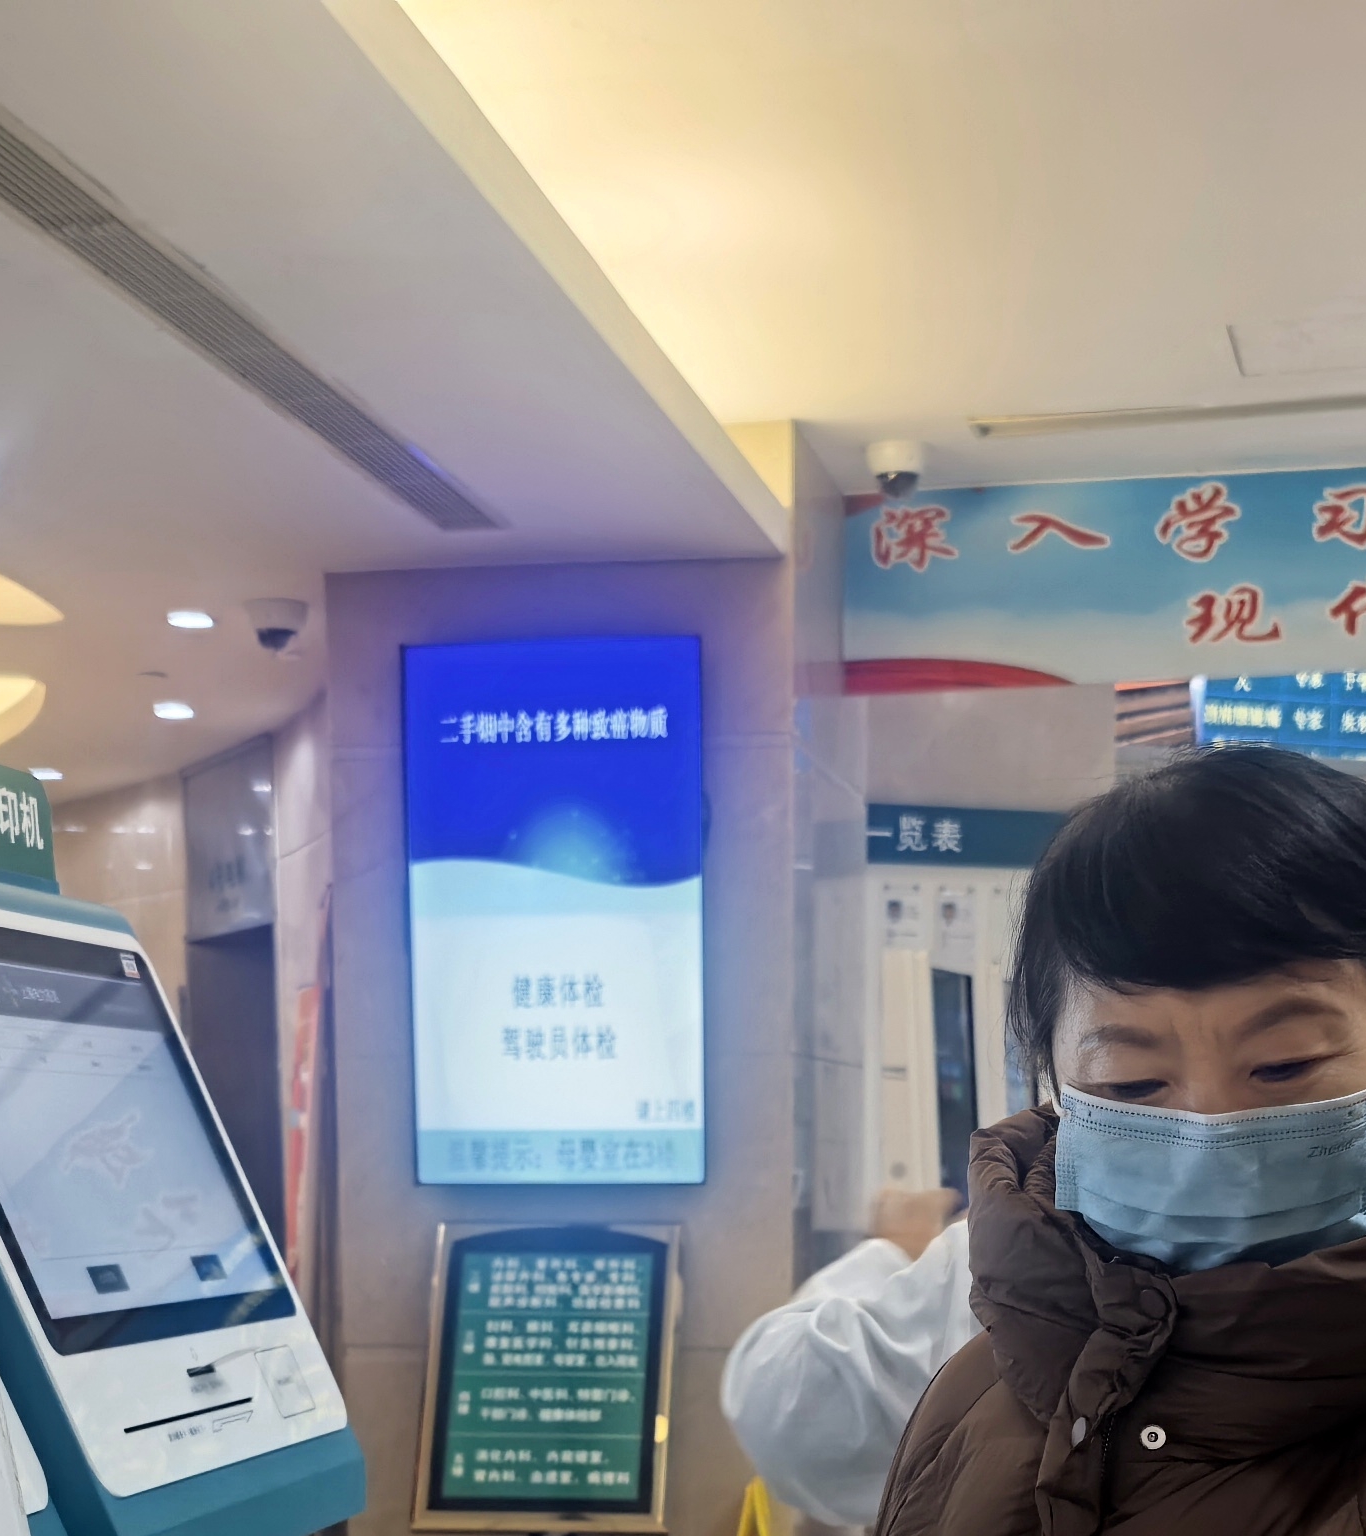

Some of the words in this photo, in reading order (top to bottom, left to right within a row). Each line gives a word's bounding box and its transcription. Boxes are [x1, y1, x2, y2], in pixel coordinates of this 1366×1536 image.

[439, 704, 670, 745] 二手烟中含有多种致癌物质
[867, 815, 964, 855] 一览表
[511, 972, 605, 1011] 健康体检
[500, 1025, 619, 1062] 驾驶员体检
